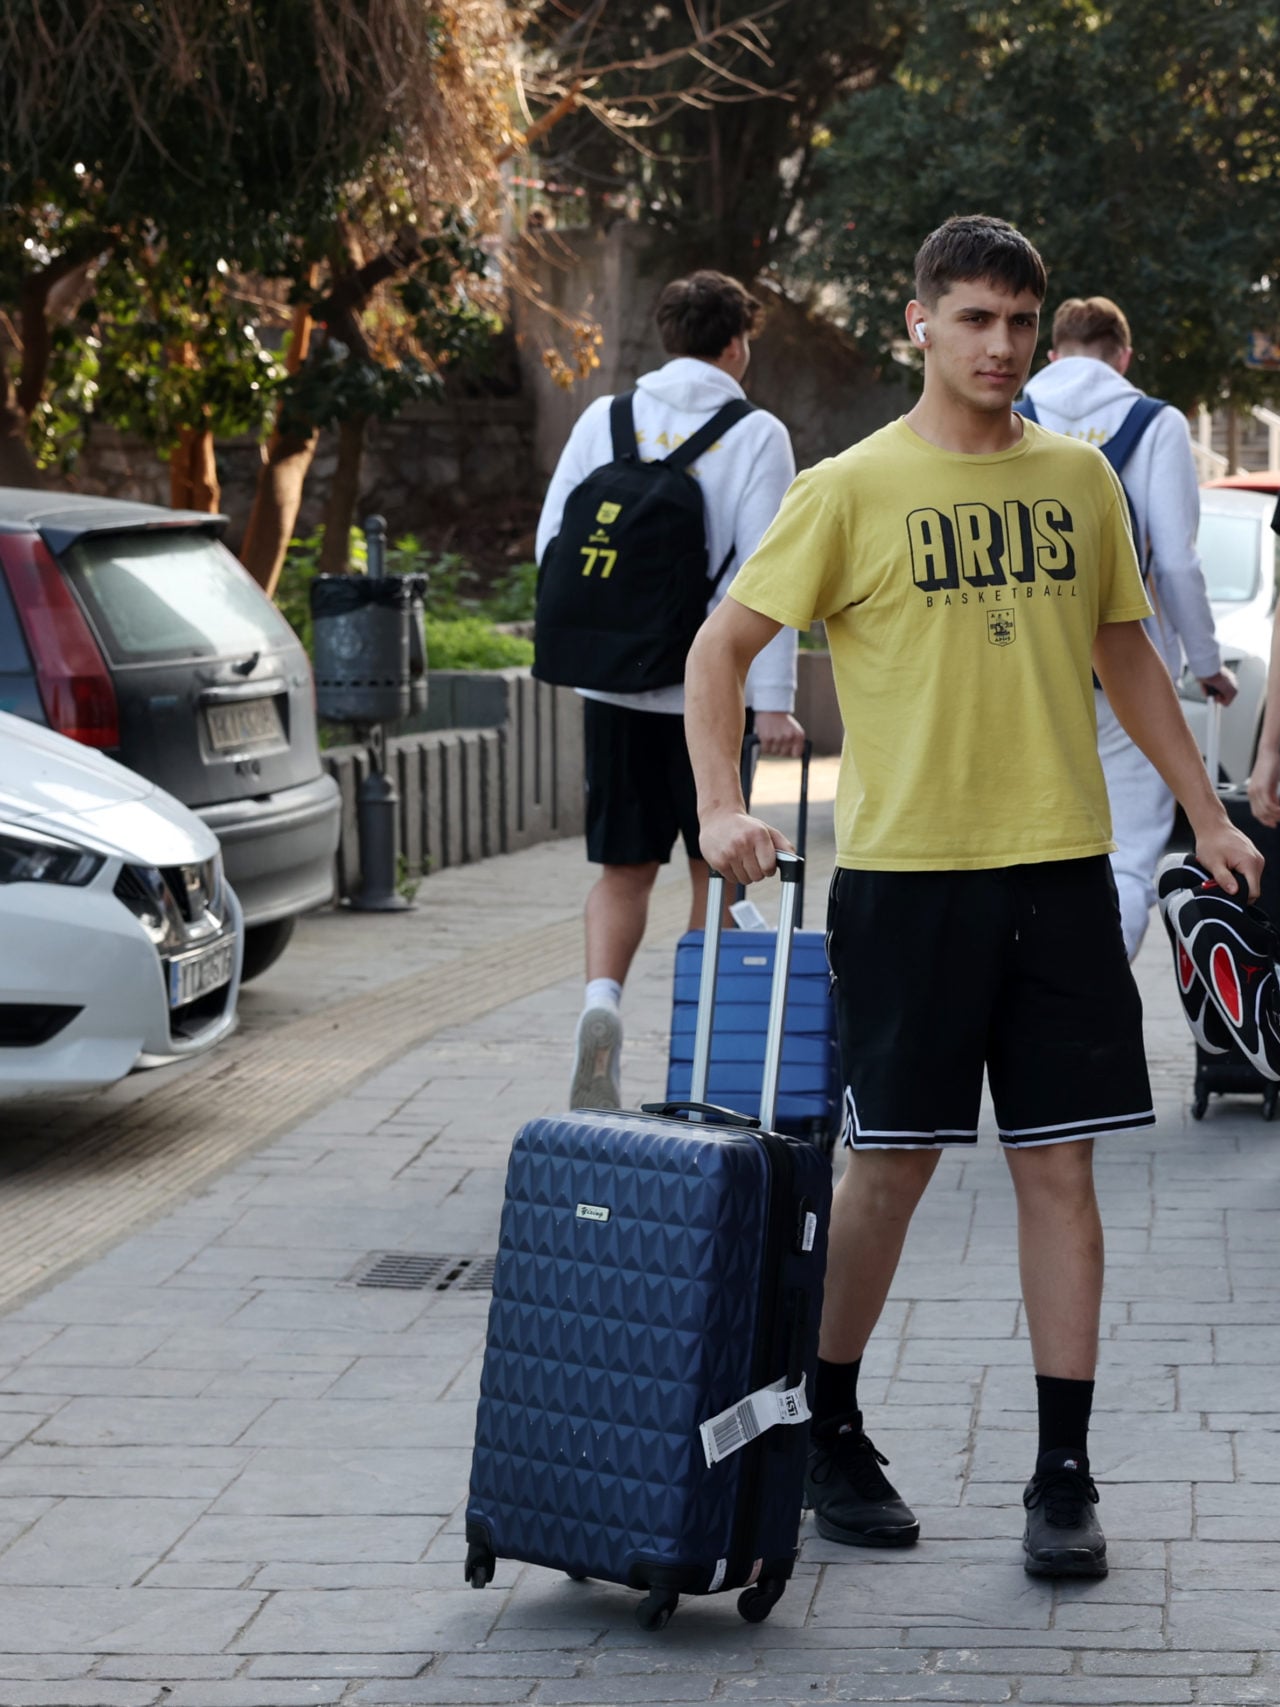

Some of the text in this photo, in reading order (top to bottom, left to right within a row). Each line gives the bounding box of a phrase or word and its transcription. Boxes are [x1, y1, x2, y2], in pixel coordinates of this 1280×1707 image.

[580, 546, 618, 578] 77
[906, 499, 1076, 593] ARIS
[926, 585, 1077, 608] BASKETBALL
